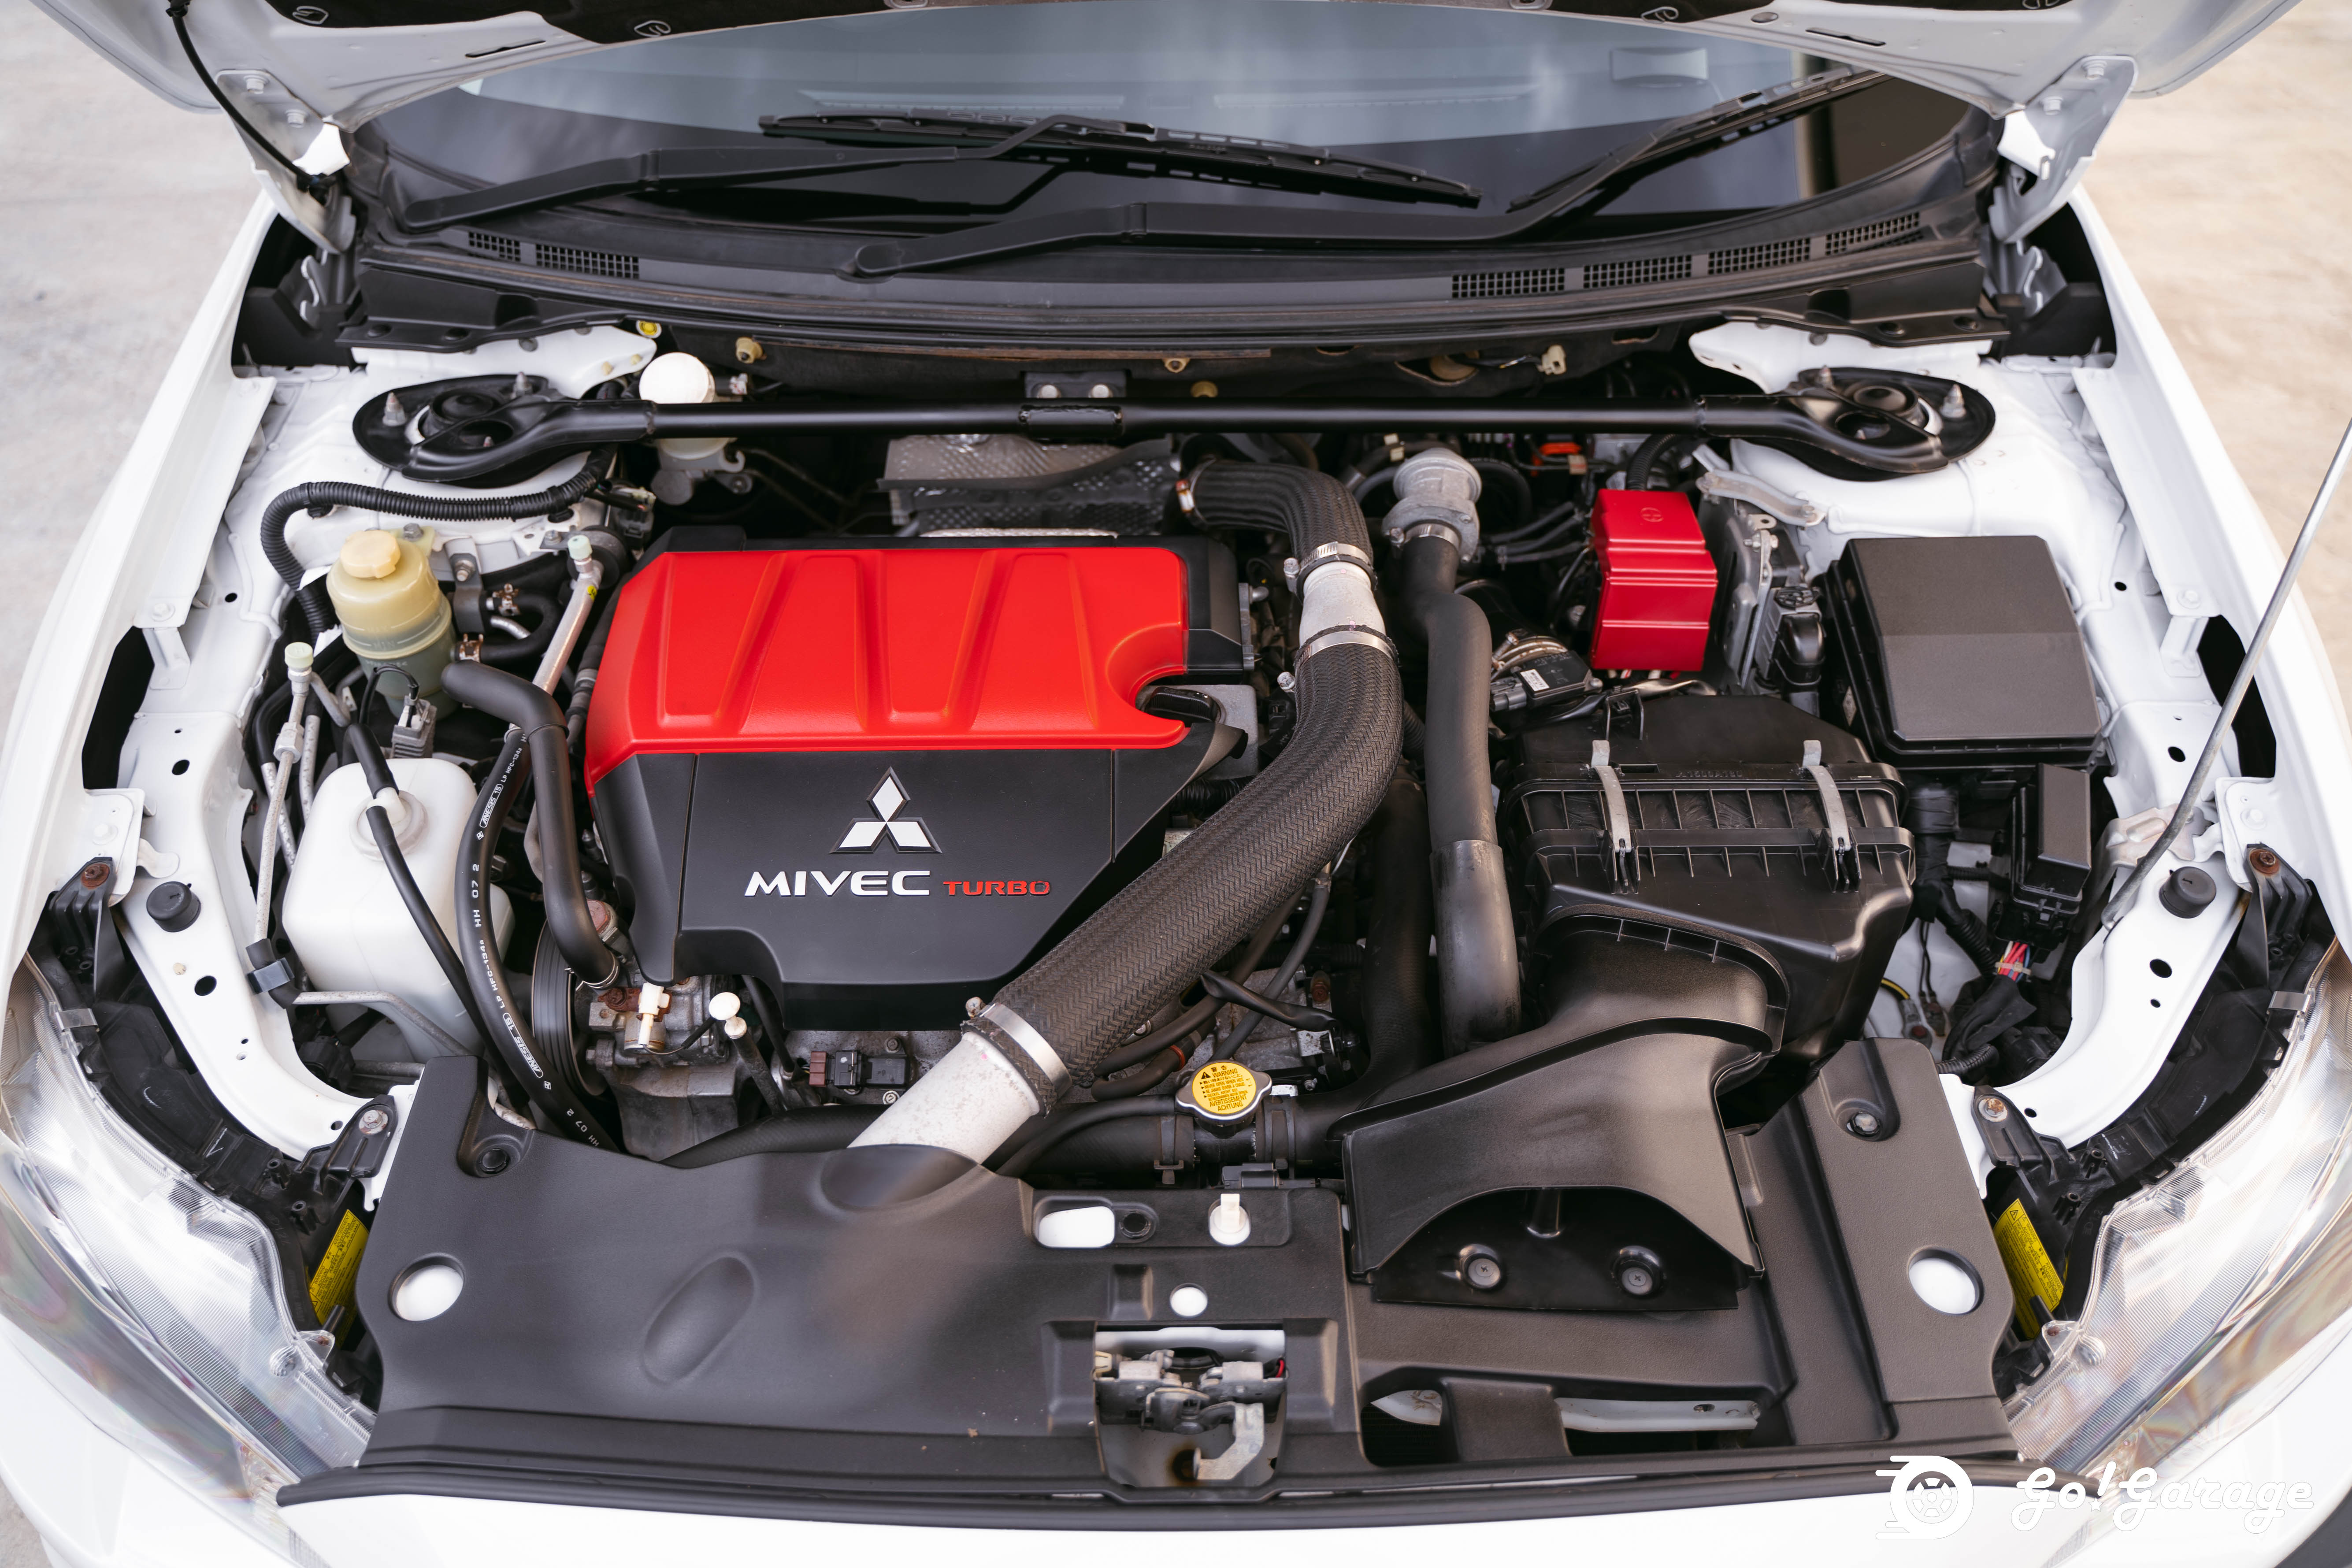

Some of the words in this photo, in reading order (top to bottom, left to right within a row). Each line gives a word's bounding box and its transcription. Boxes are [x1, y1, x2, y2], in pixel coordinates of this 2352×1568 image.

[501, 775, 508, 783] LP
[472, 880, 479, 898] 07
[744, 870, 931, 897] MIVEC
[942, 880, 1051, 897] TURBO
[473, 909, 482, 927] HH
[496, 995, 505, 1008] LP
[505, 1016, 515, 1031] 15
[1212, 1068, 1238, 1078] WARNING
[1209, 1094, 1247, 1107] AVERTISSEMENT
[1217, 1101, 1243, 1111] ACHTUNG
[575, 1120, 588, 1132] 07
[588, 1135, 600, 1146] HH
